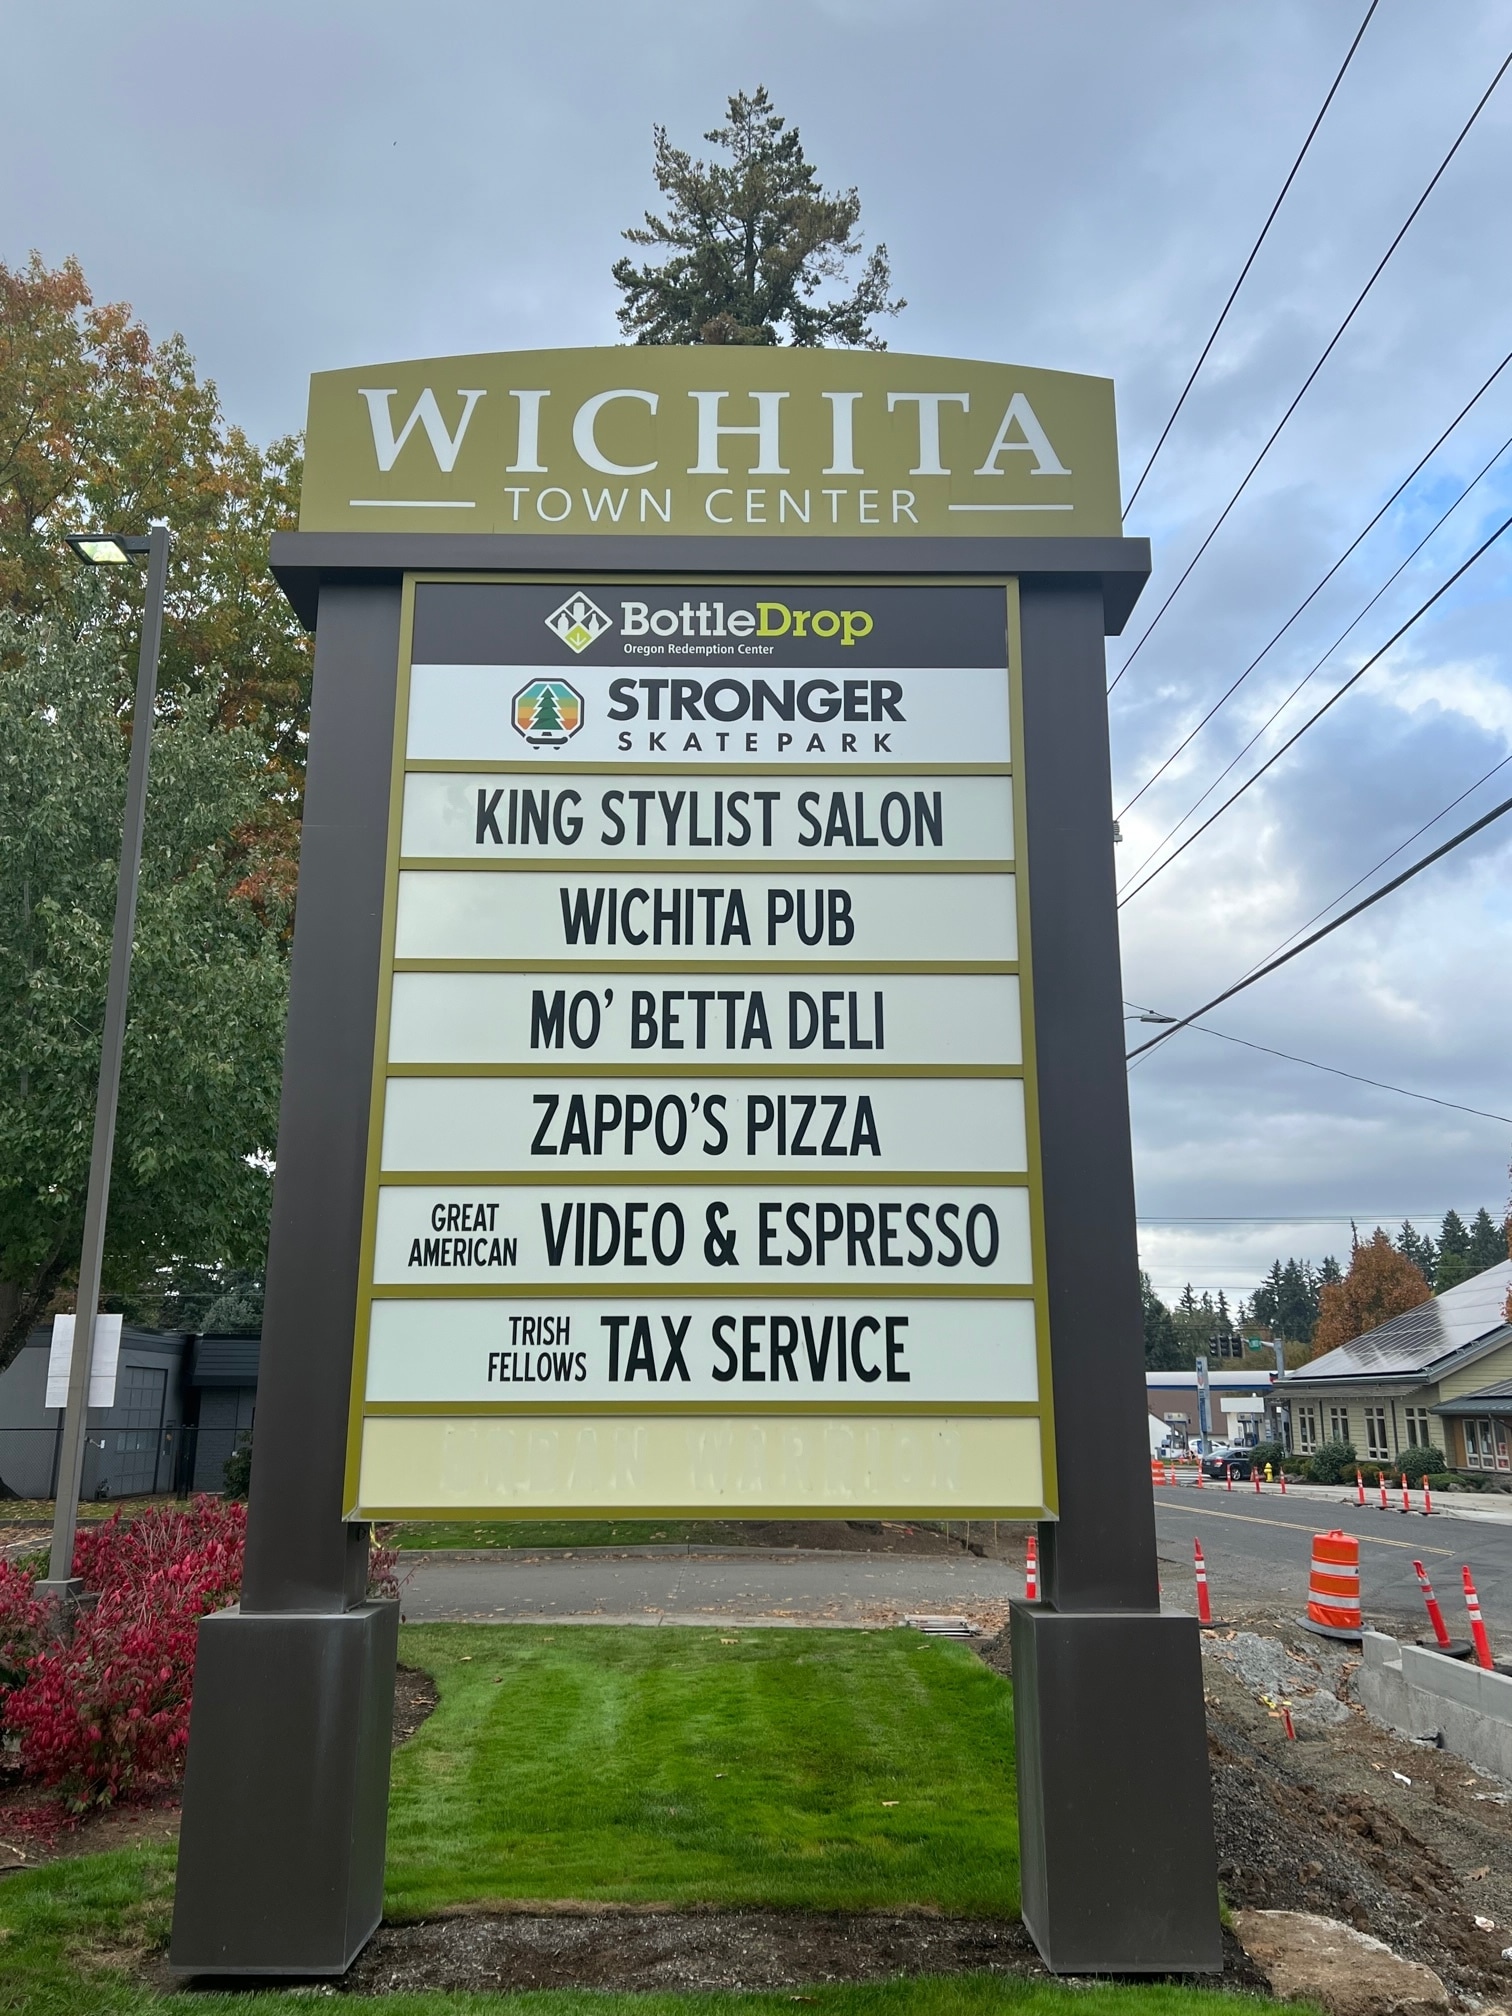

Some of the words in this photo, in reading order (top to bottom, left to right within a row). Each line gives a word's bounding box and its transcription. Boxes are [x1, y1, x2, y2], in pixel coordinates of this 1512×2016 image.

[357, 387, 1072, 477] WICHITA
[504, 487, 671, 522] TOWN
[705, 487, 919, 524] CENTER
[620, 601, 874, 646] BottleDrop
[623, 643, 665, 657] Oregon
[668, 643, 735, 657] Redemption
[737, 643, 774, 655] Center
[606, 677, 907, 723] STRONGER
[617, 731, 892, 753] SKATEPARK
[475, 788, 584, 846] KING
[600, 789, 781, 847] STYLIST
[797, 791, 943, 847] SALON
[559, 887, 752, 946] WICHITA
[767, 888, 855, 946] PUB
[630, 990, 773, 1050] BETTA
[788, 990, 885, 1050] DELI
[747, 1094, 882, 1157] PIZZA
[431, 1203, 500, 1233] GREAT
[540, 1201, 685, 1268] VIDEO
[703, 1201, 740, 1267] &
[758, 1202, 1000, 1268] ESPRESSO
[407, 1237, 518, 1267] AMERICAN
[508, 1316, 571, 1346] TRISH
[600, 1315, 693, 1382] TAX
[711, 1315, 911, 1383] SERVICE
[487, 1351, 587, 1383] FELLOWS
